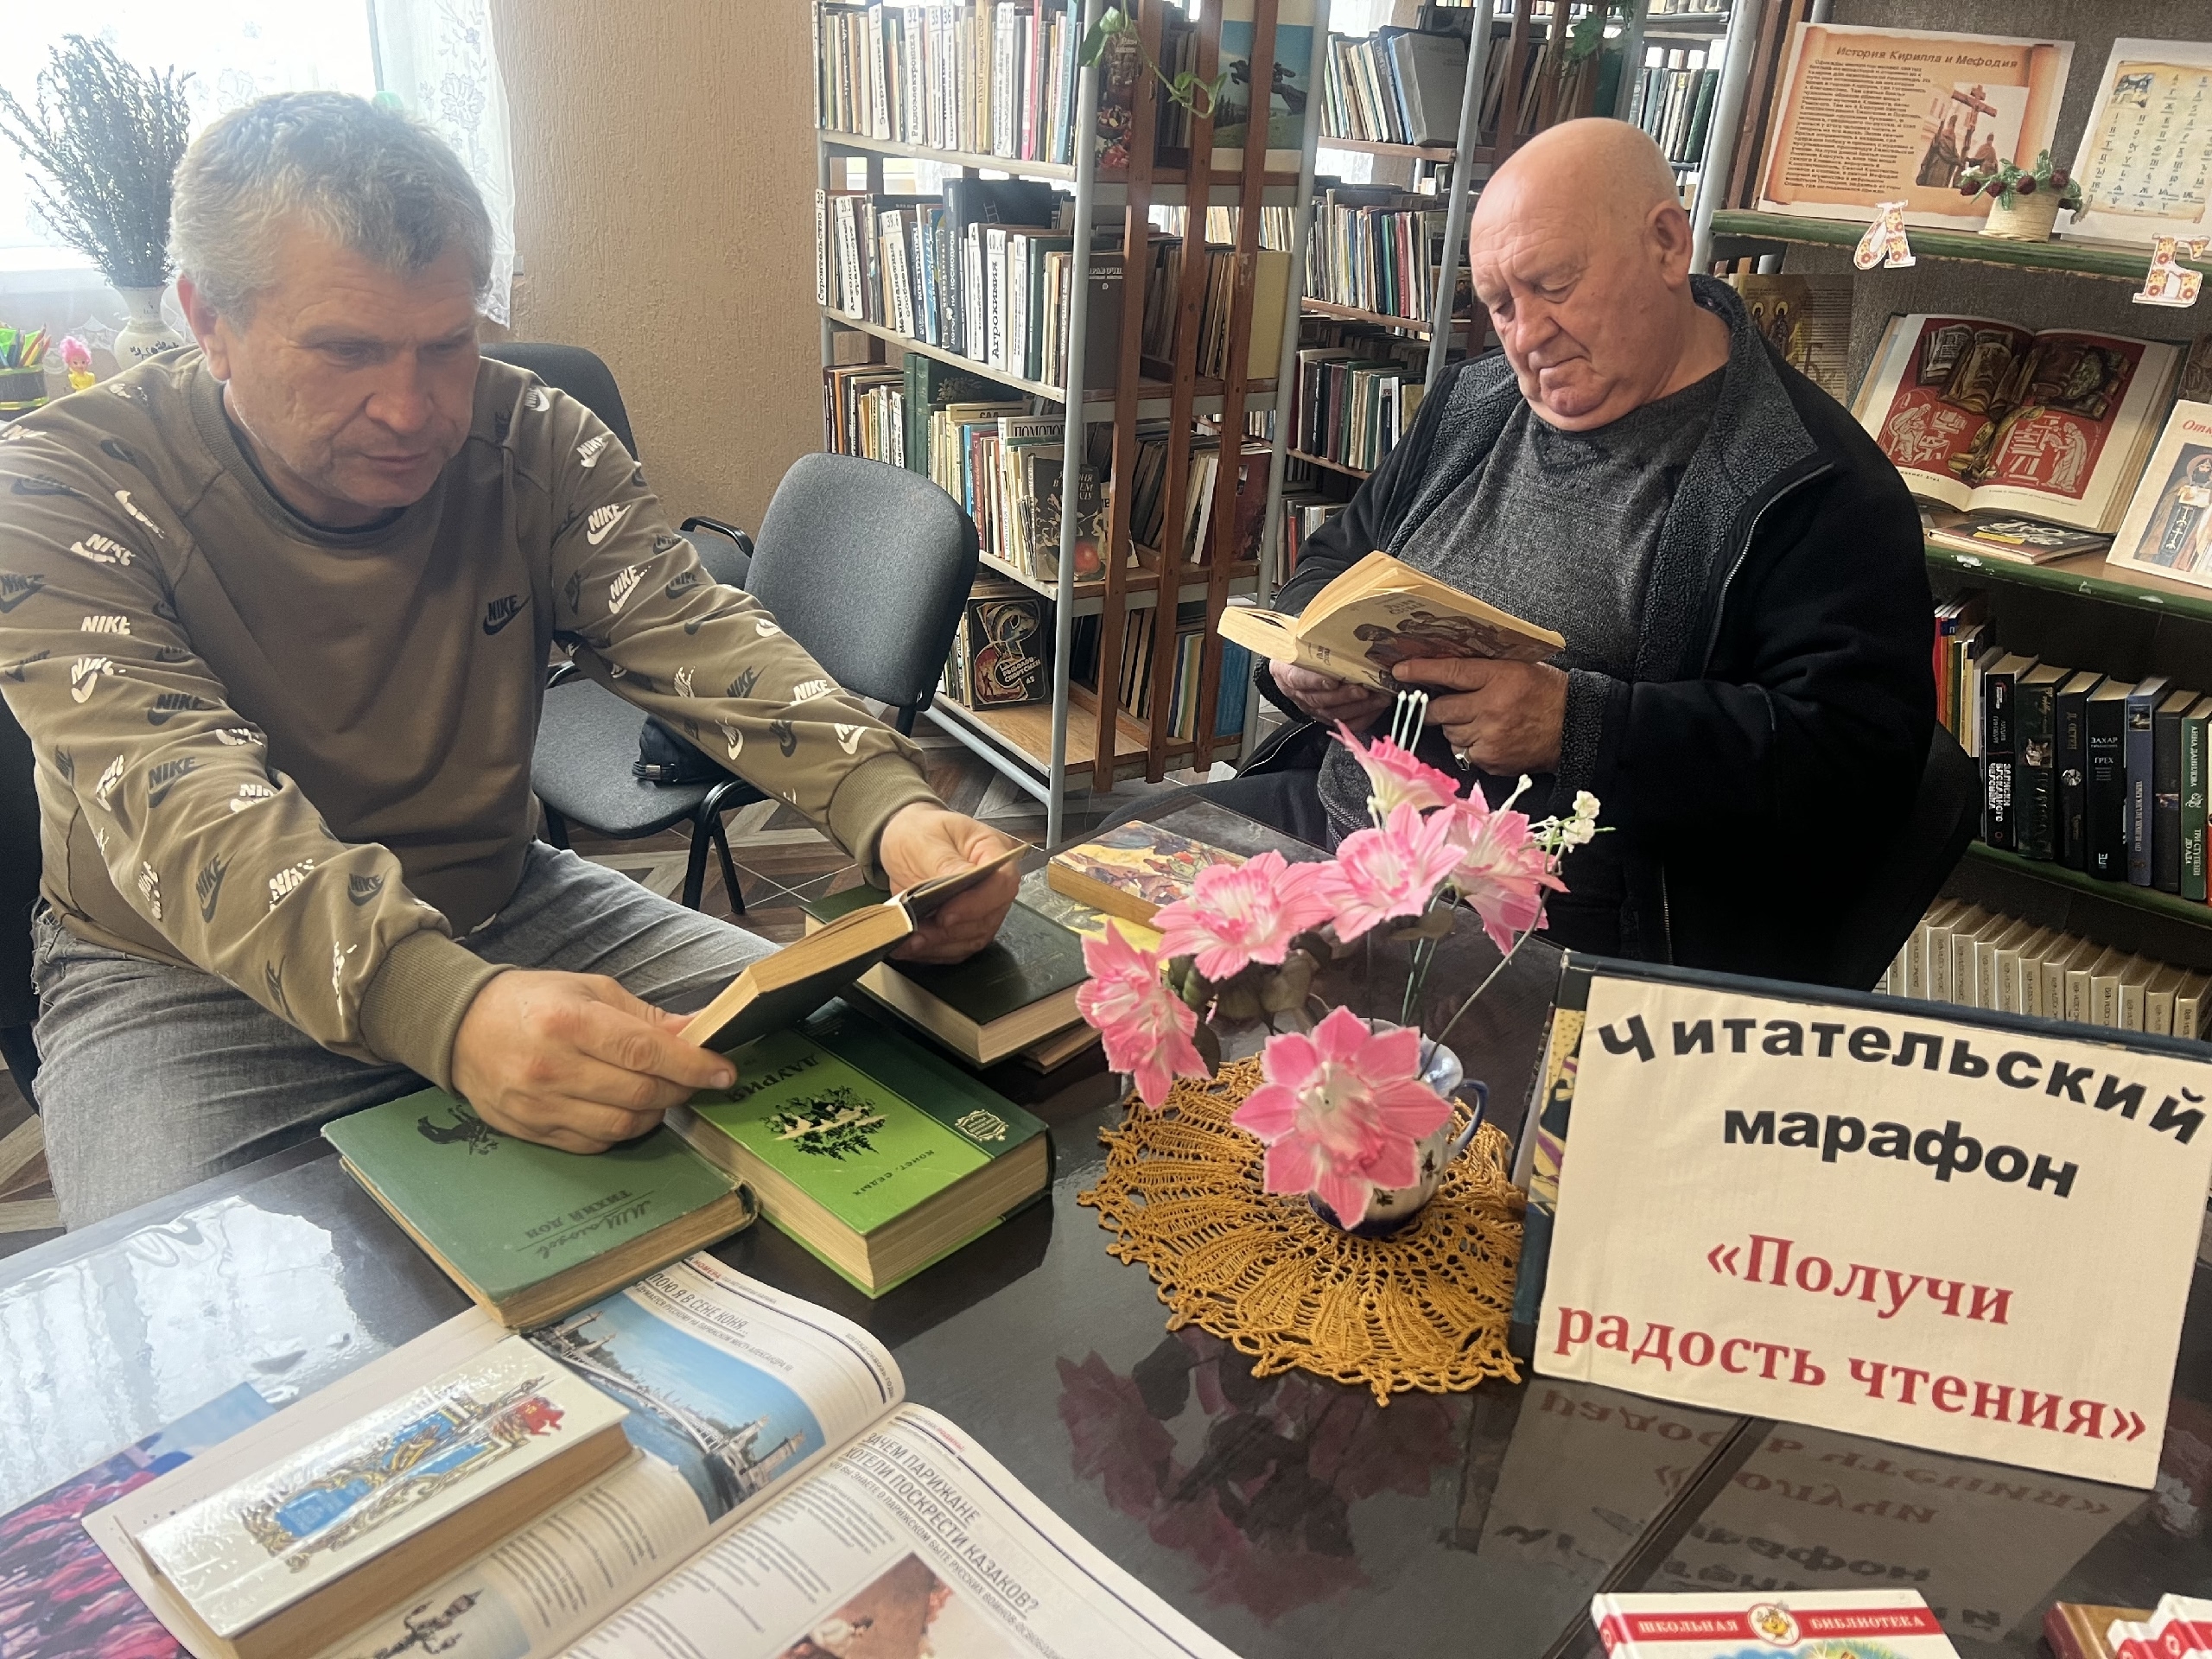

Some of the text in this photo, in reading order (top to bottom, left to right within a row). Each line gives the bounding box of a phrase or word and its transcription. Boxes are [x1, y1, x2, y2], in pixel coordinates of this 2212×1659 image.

[907, 9, 917, 23] 32
[931, 10, 938, 25] 35
[944, 9, 951, 24] 36
[1836, 46, 1886, 59] История
[1889, 51, 1942, 63] Кирилла
[1955, 55, 2018, 68] Мефодия
[909, 33, 918, 137] Радиоэлектроника
[950, 295, 956, 307] НА
[588, 503, 624, 532] NIKE
[610, 566, 638, 601] NIKE
[487, 594, 518, 622] NIKE
[81, 616, 130, 635] NIKE
[156, 693, 204, 710] NIKE
[793, 679, 829, 701] NIKE
[148, 756, 197, 788] NIKE
[2003, 763, 2012, 807] ЗАПИСКИ
[1995, 763, 2004, 822] БЛОКАДНОГО
[195, 852, 223, 906] NIKE
[348, 873, 383, 893] NIKE
[725, 1052, 818, 1103] ДАУРИЯ
[1599, 1014, 2207, 1146] Читательский
[1723, 1109, 2079, 1198] марафон
[851, 1171, 893, 1197] СЕДЫХ
[525, 1189, 632, 1240] ТИХИЙ ДОН
[693, 1259, 722, 1279] НОМЕРА
[1707, 1234, 2013, 1325] «Получи
[689, 1293, 718, 1317] СЕНЕ
[1554, 1305, 2146, 1442] радость чтения»
[864, 1433, 908, 1460] ЗАЧЕМ
[902, 1455, 980, 1524] ПАРИЖАНЕ
[843, 1446, 891, 1479] ХОТЕЛИ
[888, 1470, 969, 1547] ПОСКРЕСТИ
[963, 1542, 1039, 1612] КАЗАКОВ?
[1637, 1614, 1926, 1634] ШКОЛЬНАЯ БИБЛИОТЕКА
